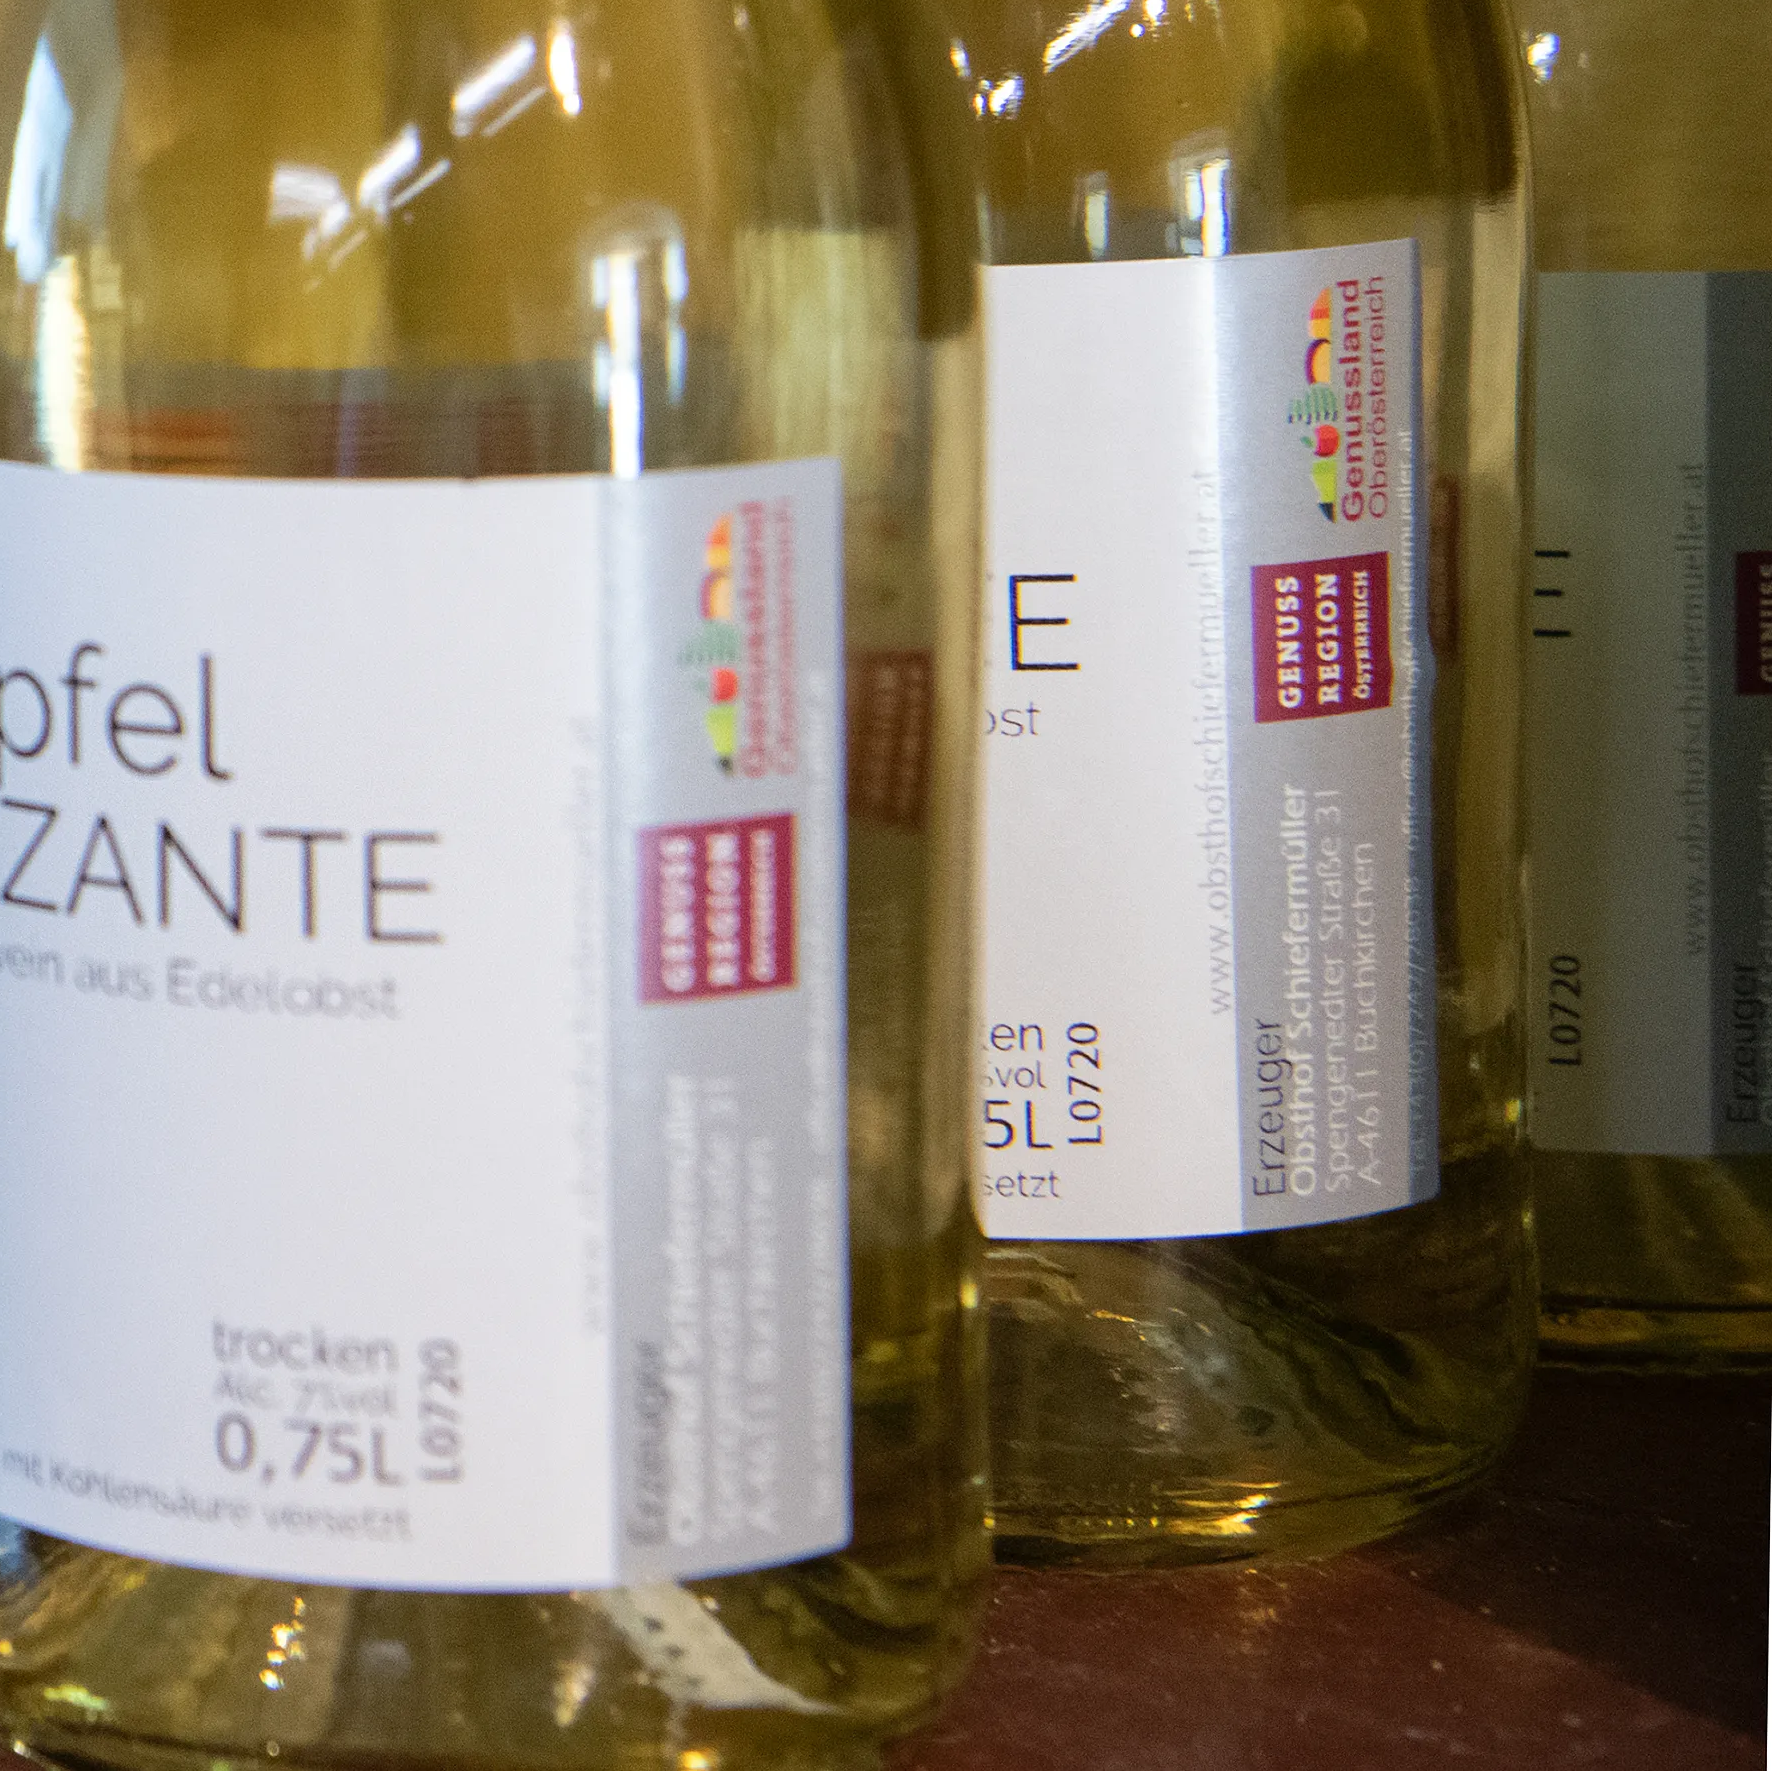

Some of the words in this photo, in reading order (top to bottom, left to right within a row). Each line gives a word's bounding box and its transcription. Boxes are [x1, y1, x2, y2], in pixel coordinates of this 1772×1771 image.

[1335, 276, 1365, 523] Genussland
[1363, 274, 1390, 519] Oberösterreich
[1273, 574, 1303, 708] GENUSS
[1313, 571, 1342, 703] REGION
[1351, 569, 1373, 699] ÖSTERREICH
[1188, 470, 1232, 1016] www.obsthofschiefermueller.at
[1314, 788, 1342, 825] 31
[1279, 781, 1314, 1039] Schiefermüller
[1314, 833, 1345, 941] Straße
[1350, 841, 1380, 1051] Buchkirchen
[1317, 951, 1357, 1192] Spengenedter
[1546, 952, 1585, 1068] L0720
[1066, 1022, 1104, 1145] L0720
[1251, 1015, 1294, 1196] Erzeuger
[1285, 1048, 1317, 1196] Obsthof
[211, 1319, 401, 1374] trocken
[416, 1336, 466, 1485] L0720
[214, 1408, 409, 1488] 0,75L
